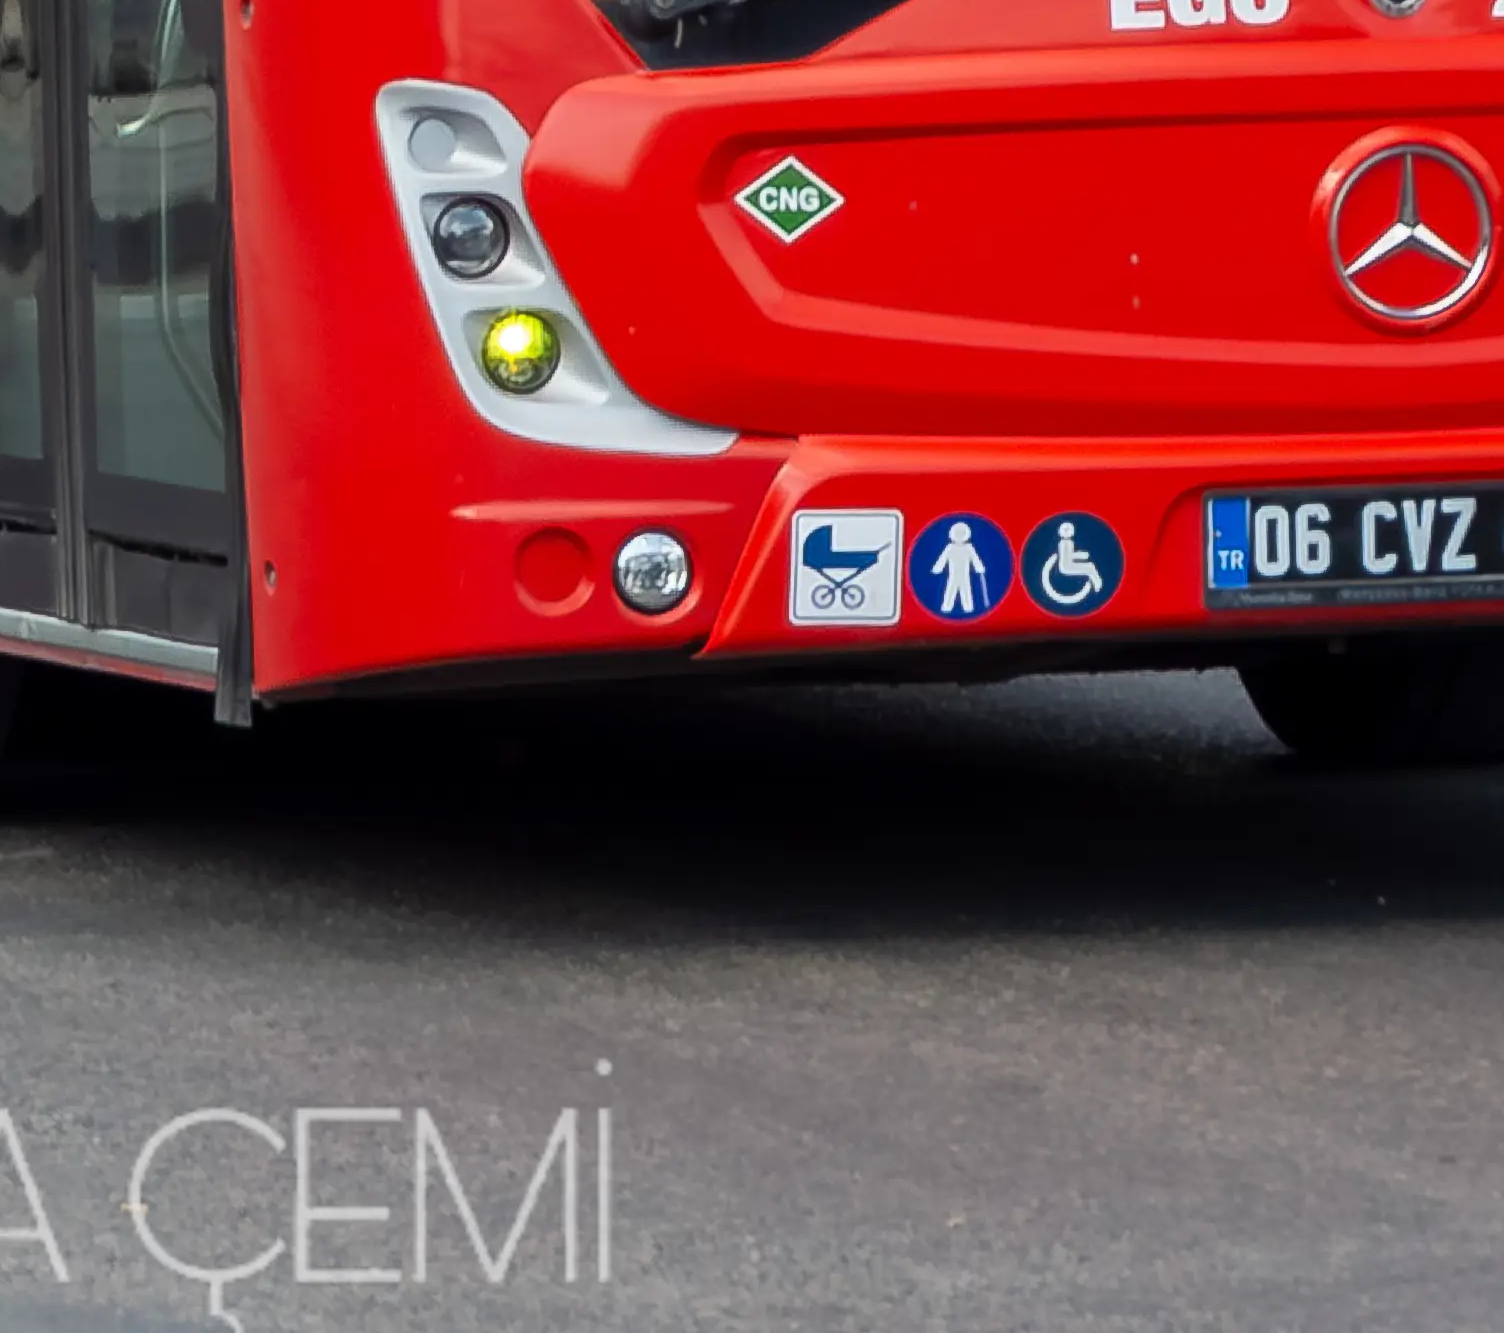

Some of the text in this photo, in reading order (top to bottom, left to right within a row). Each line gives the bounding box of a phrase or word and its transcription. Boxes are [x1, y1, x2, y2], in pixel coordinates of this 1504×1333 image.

[758, 185, 821, 213] CNG
[1217, 549, 1245, 571] TR
[1253, 503, 1332, 577] 06
[1361, 497, 1477, 575] CVZ
